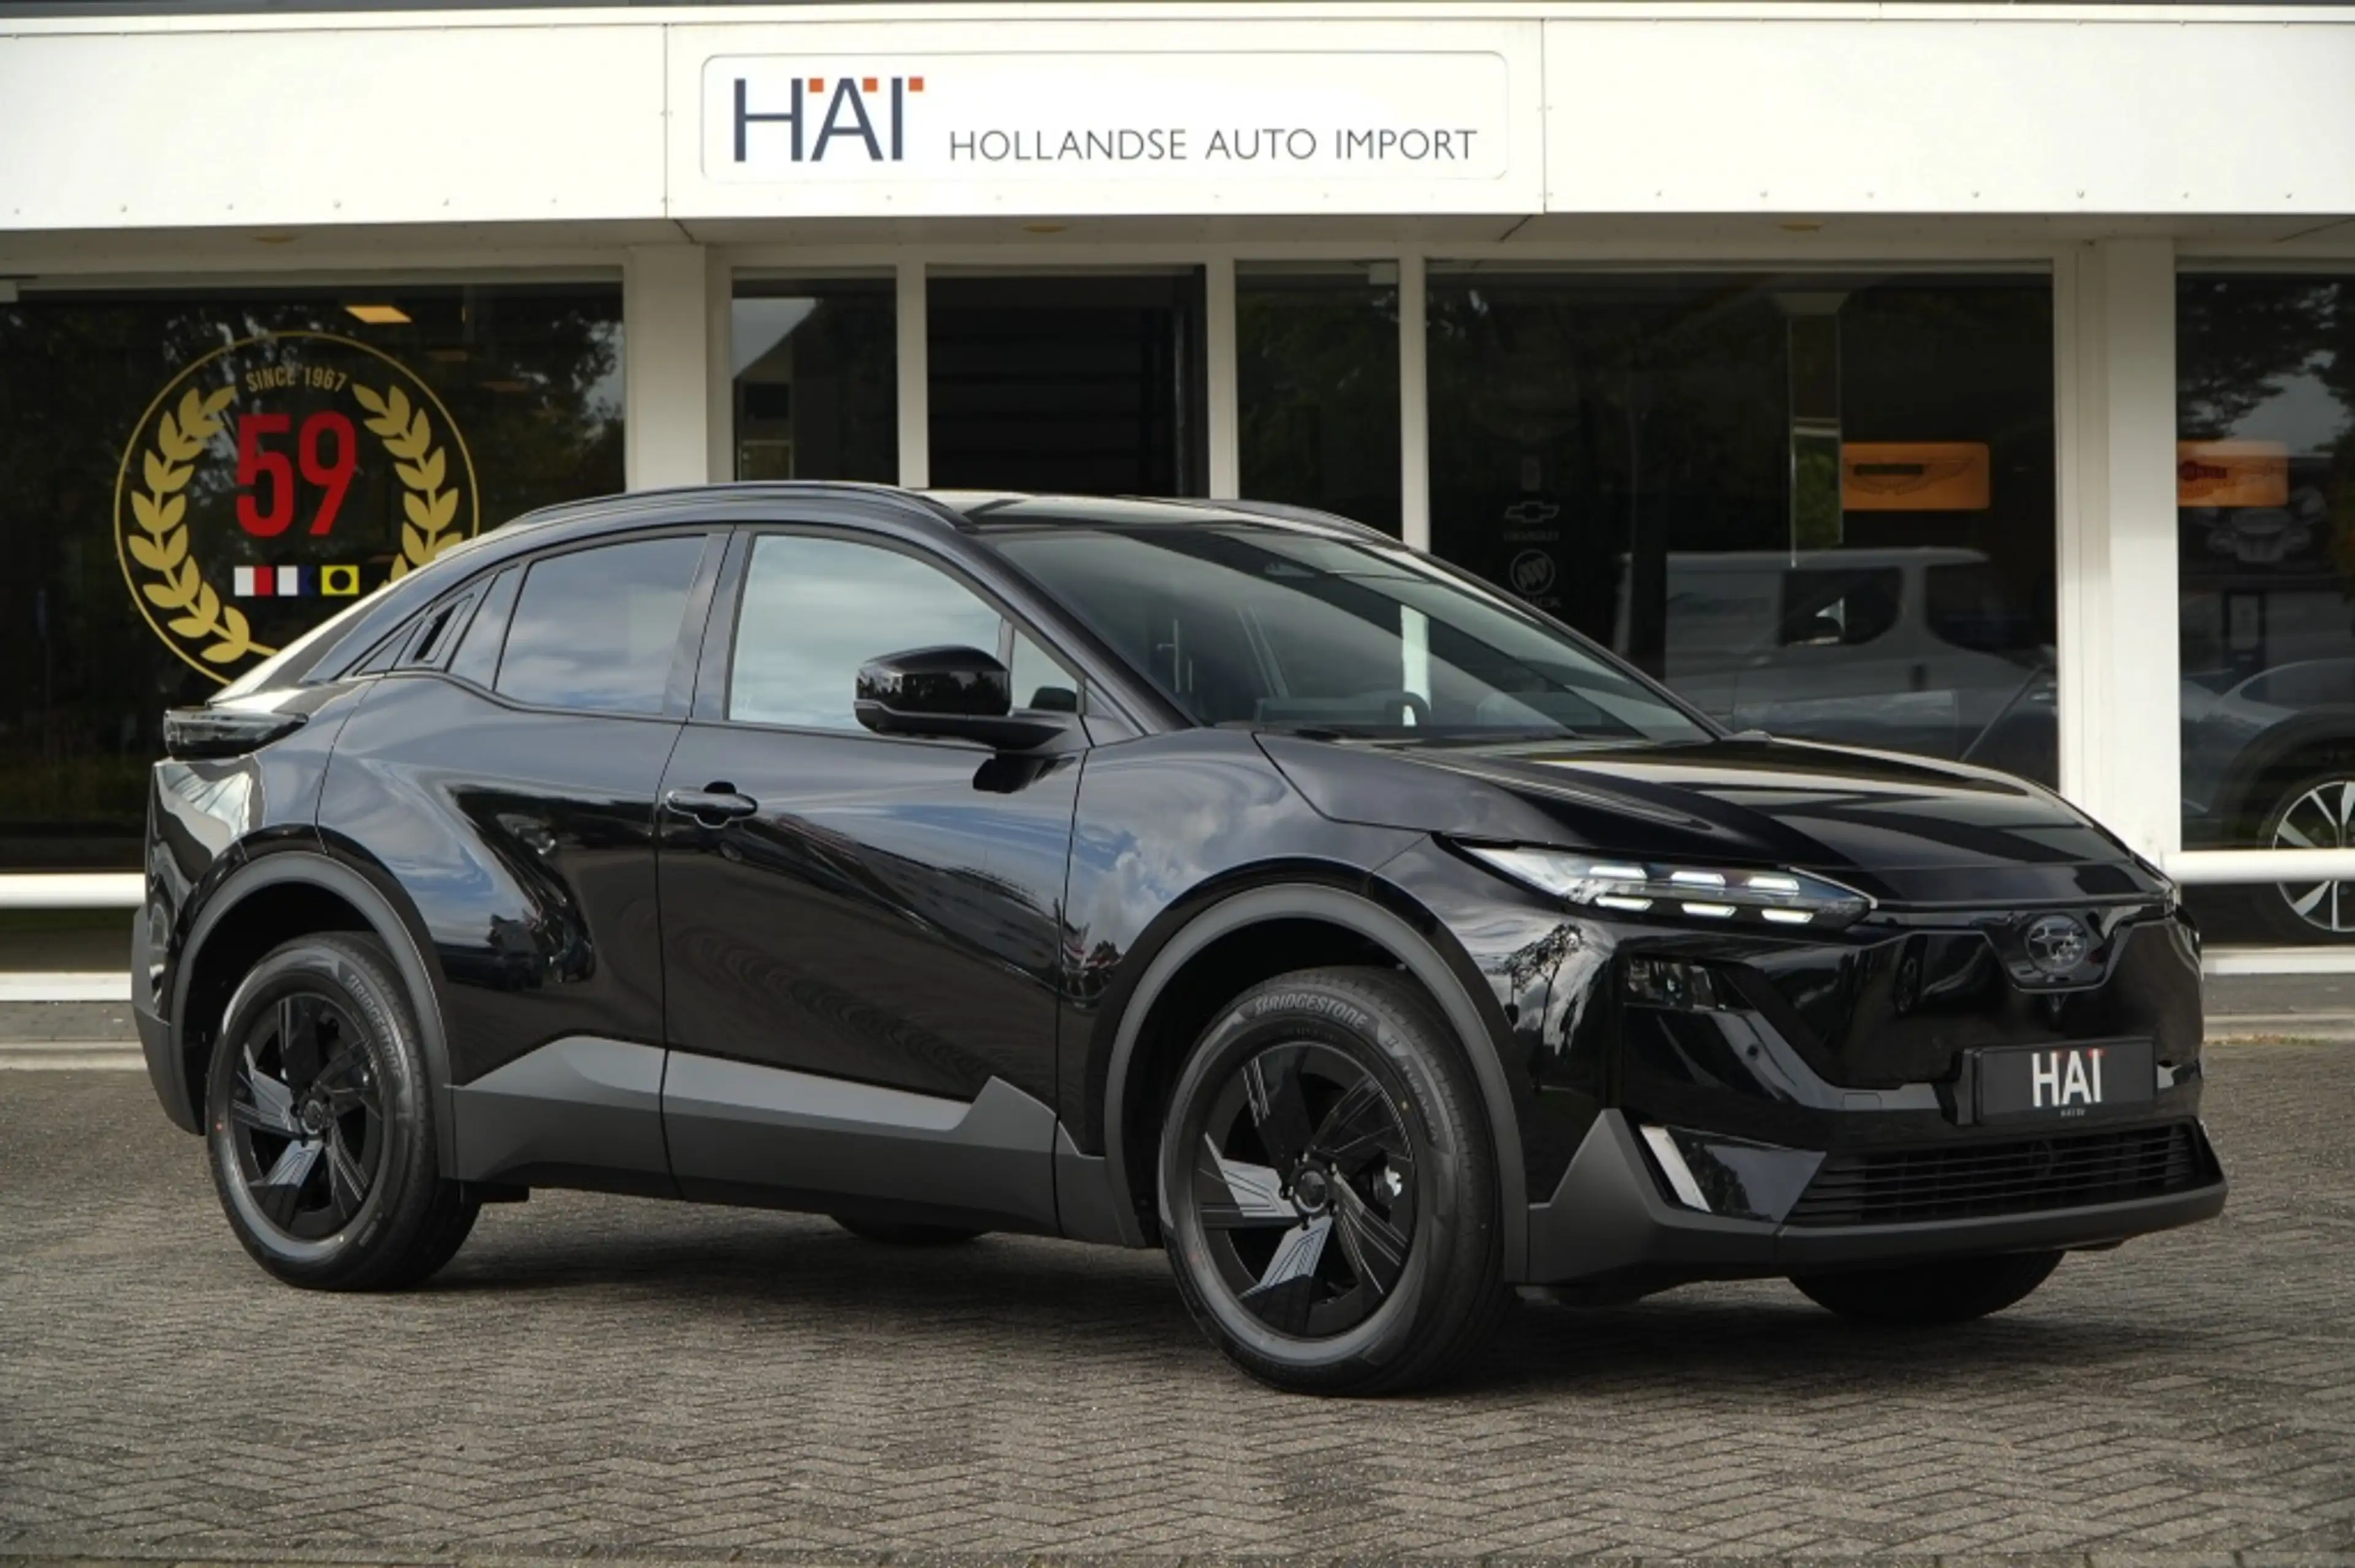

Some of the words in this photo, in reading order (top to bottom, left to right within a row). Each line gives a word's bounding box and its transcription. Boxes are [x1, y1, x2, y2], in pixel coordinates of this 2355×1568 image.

[734, 77, 923, 161] HAI
[950, 130, 1186, 161] HOLLANDSE
[1206, 129, 1316, 160] AUTO
[1336, 128, 1477, 159] IMPORT
[245, 366, 296, 392] SINCE
[305, 367, 347, 392] 1967
[237, 411, 356, 536] 59
[2032, 1048, 2104, 1107] HAI
